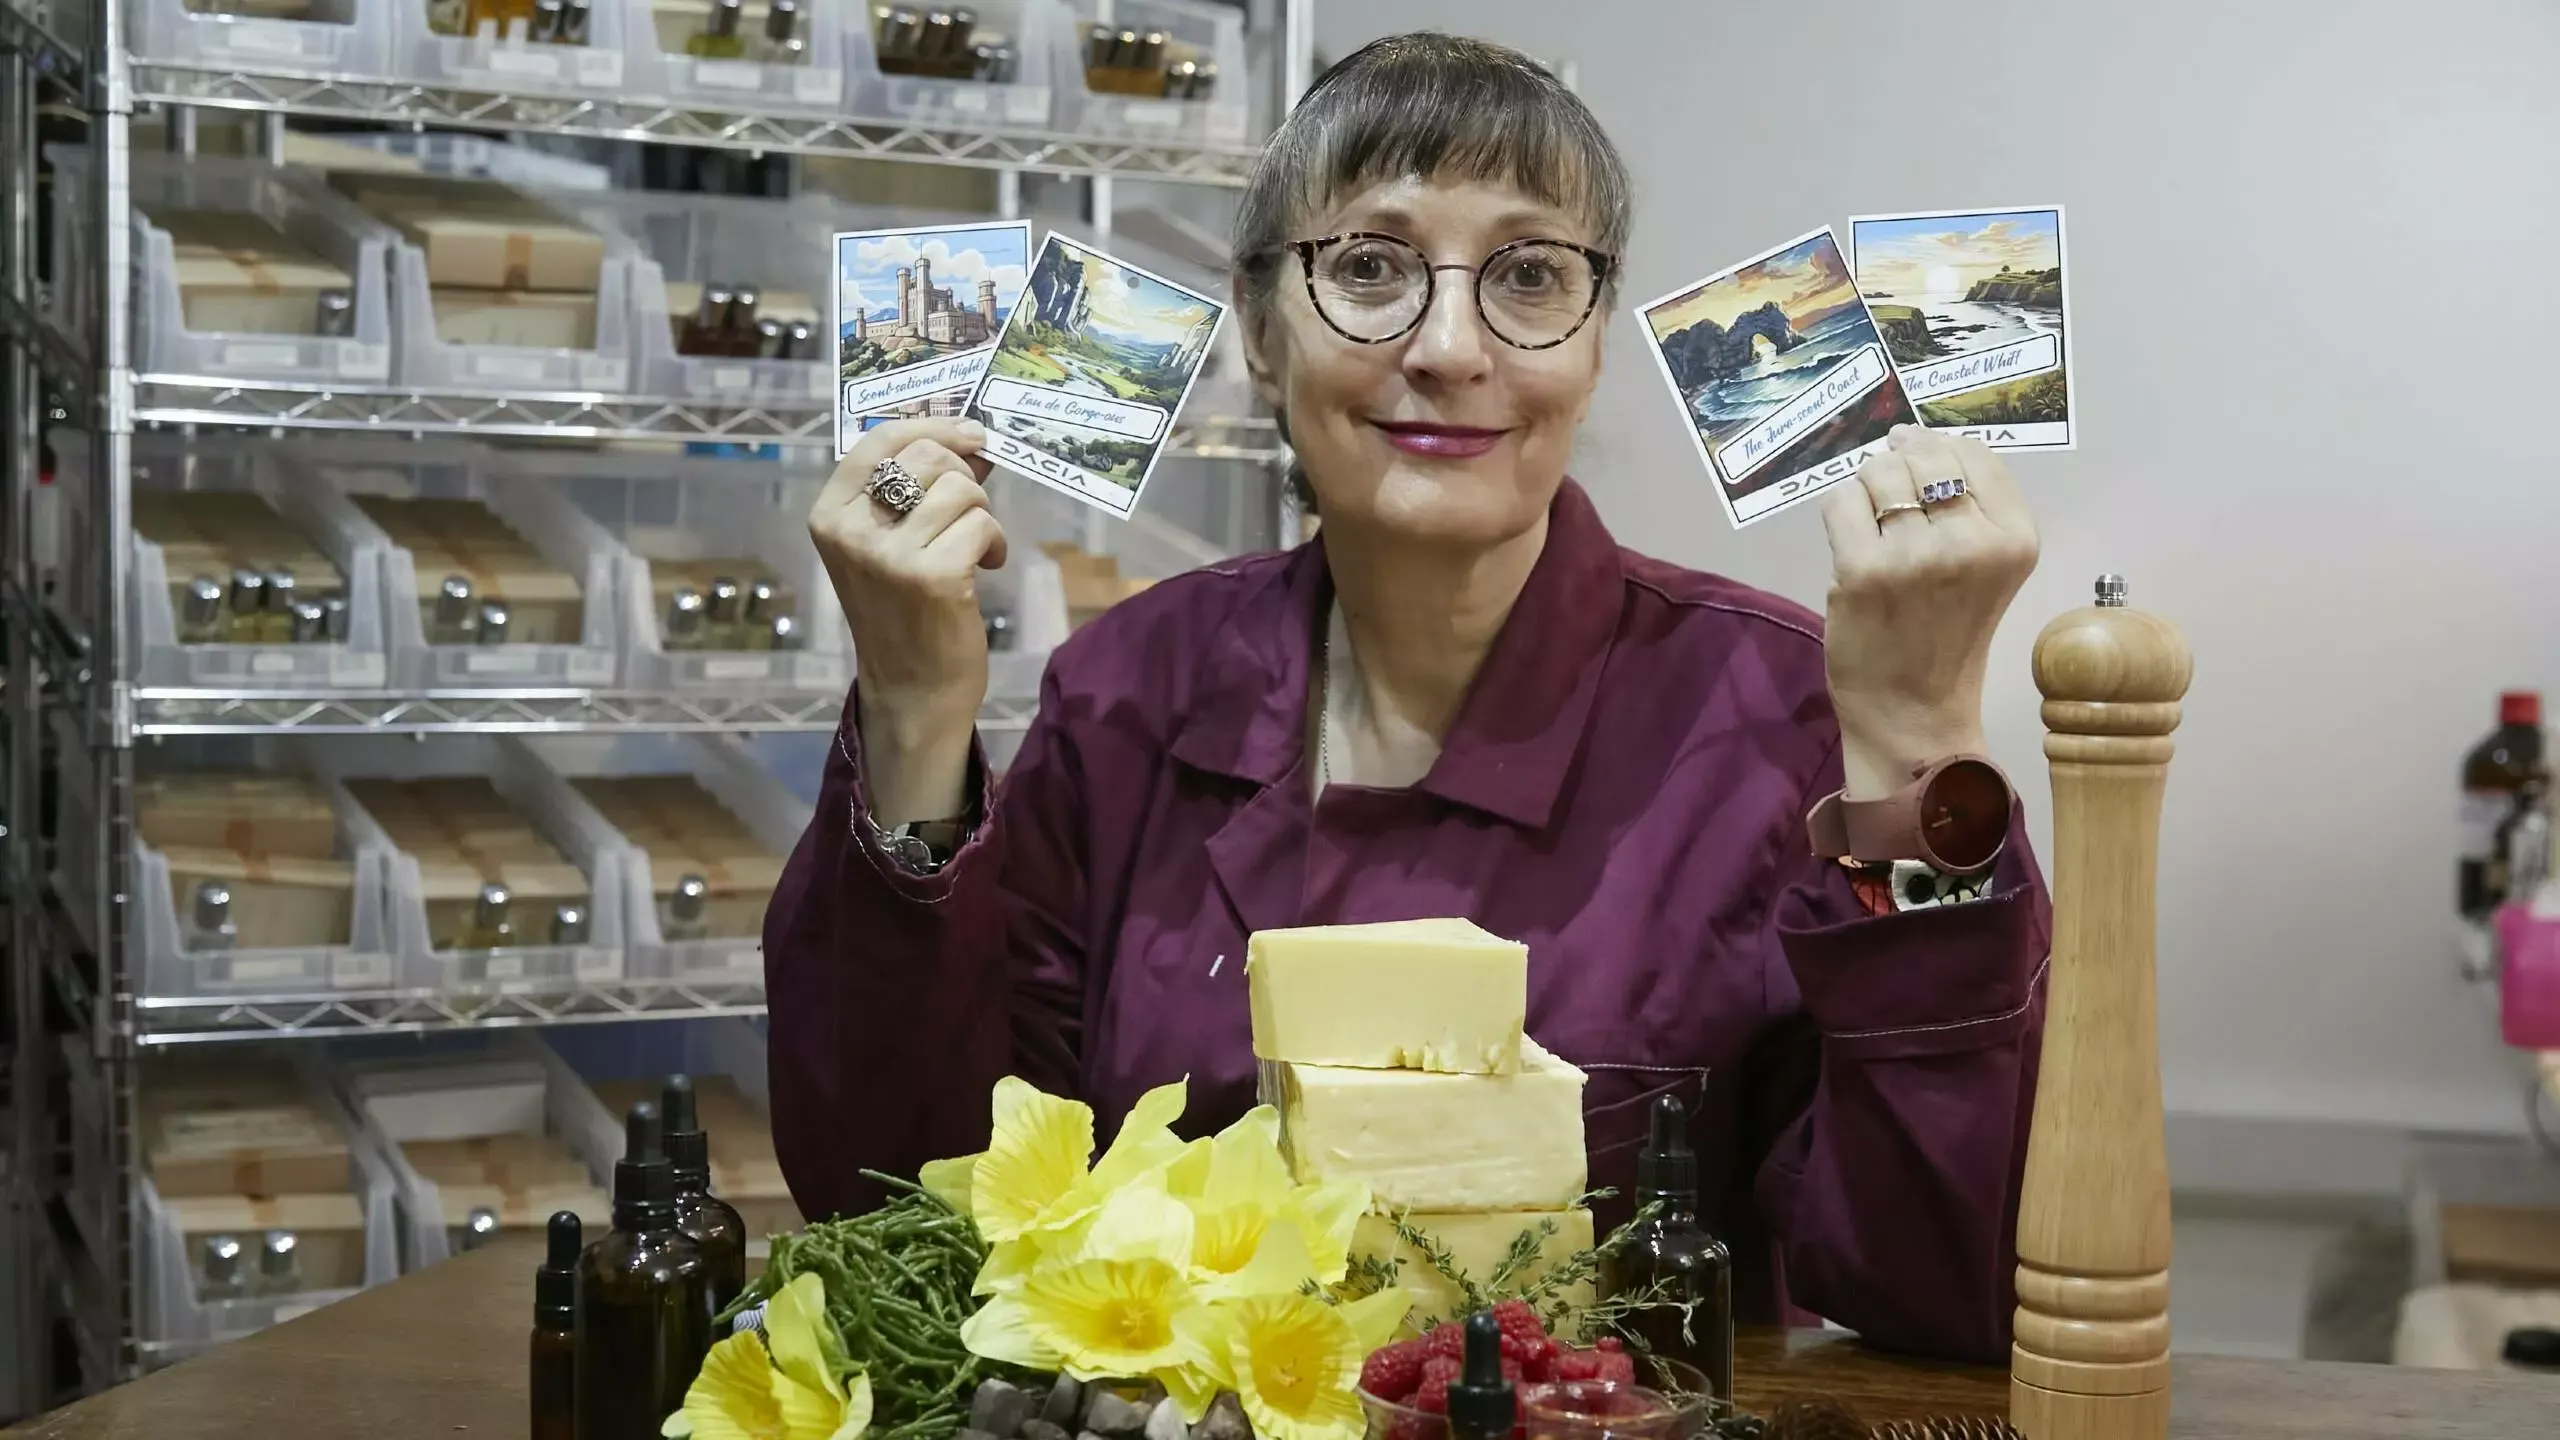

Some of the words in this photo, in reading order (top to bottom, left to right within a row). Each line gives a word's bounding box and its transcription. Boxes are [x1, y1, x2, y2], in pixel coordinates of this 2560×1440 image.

[858, 368, 945, 404] Scent-sational
[1904, 376, 1923, 392] The
[1929, 359, 1979, 387] Coastal
[1984, 349, 2022, 372] Whiff
[1017, 392, 1041, 408] Eau
[1045, 398, 1060, 411] de
[1743, 438, 1763, 460] The
[1767, 392, 1826, 442] Jura-scent
[1828, 367, 1860, 399] Coast
[1000, 441, 1086, 486] DACIA
[1780, 451, 1873, 496] DACIA
